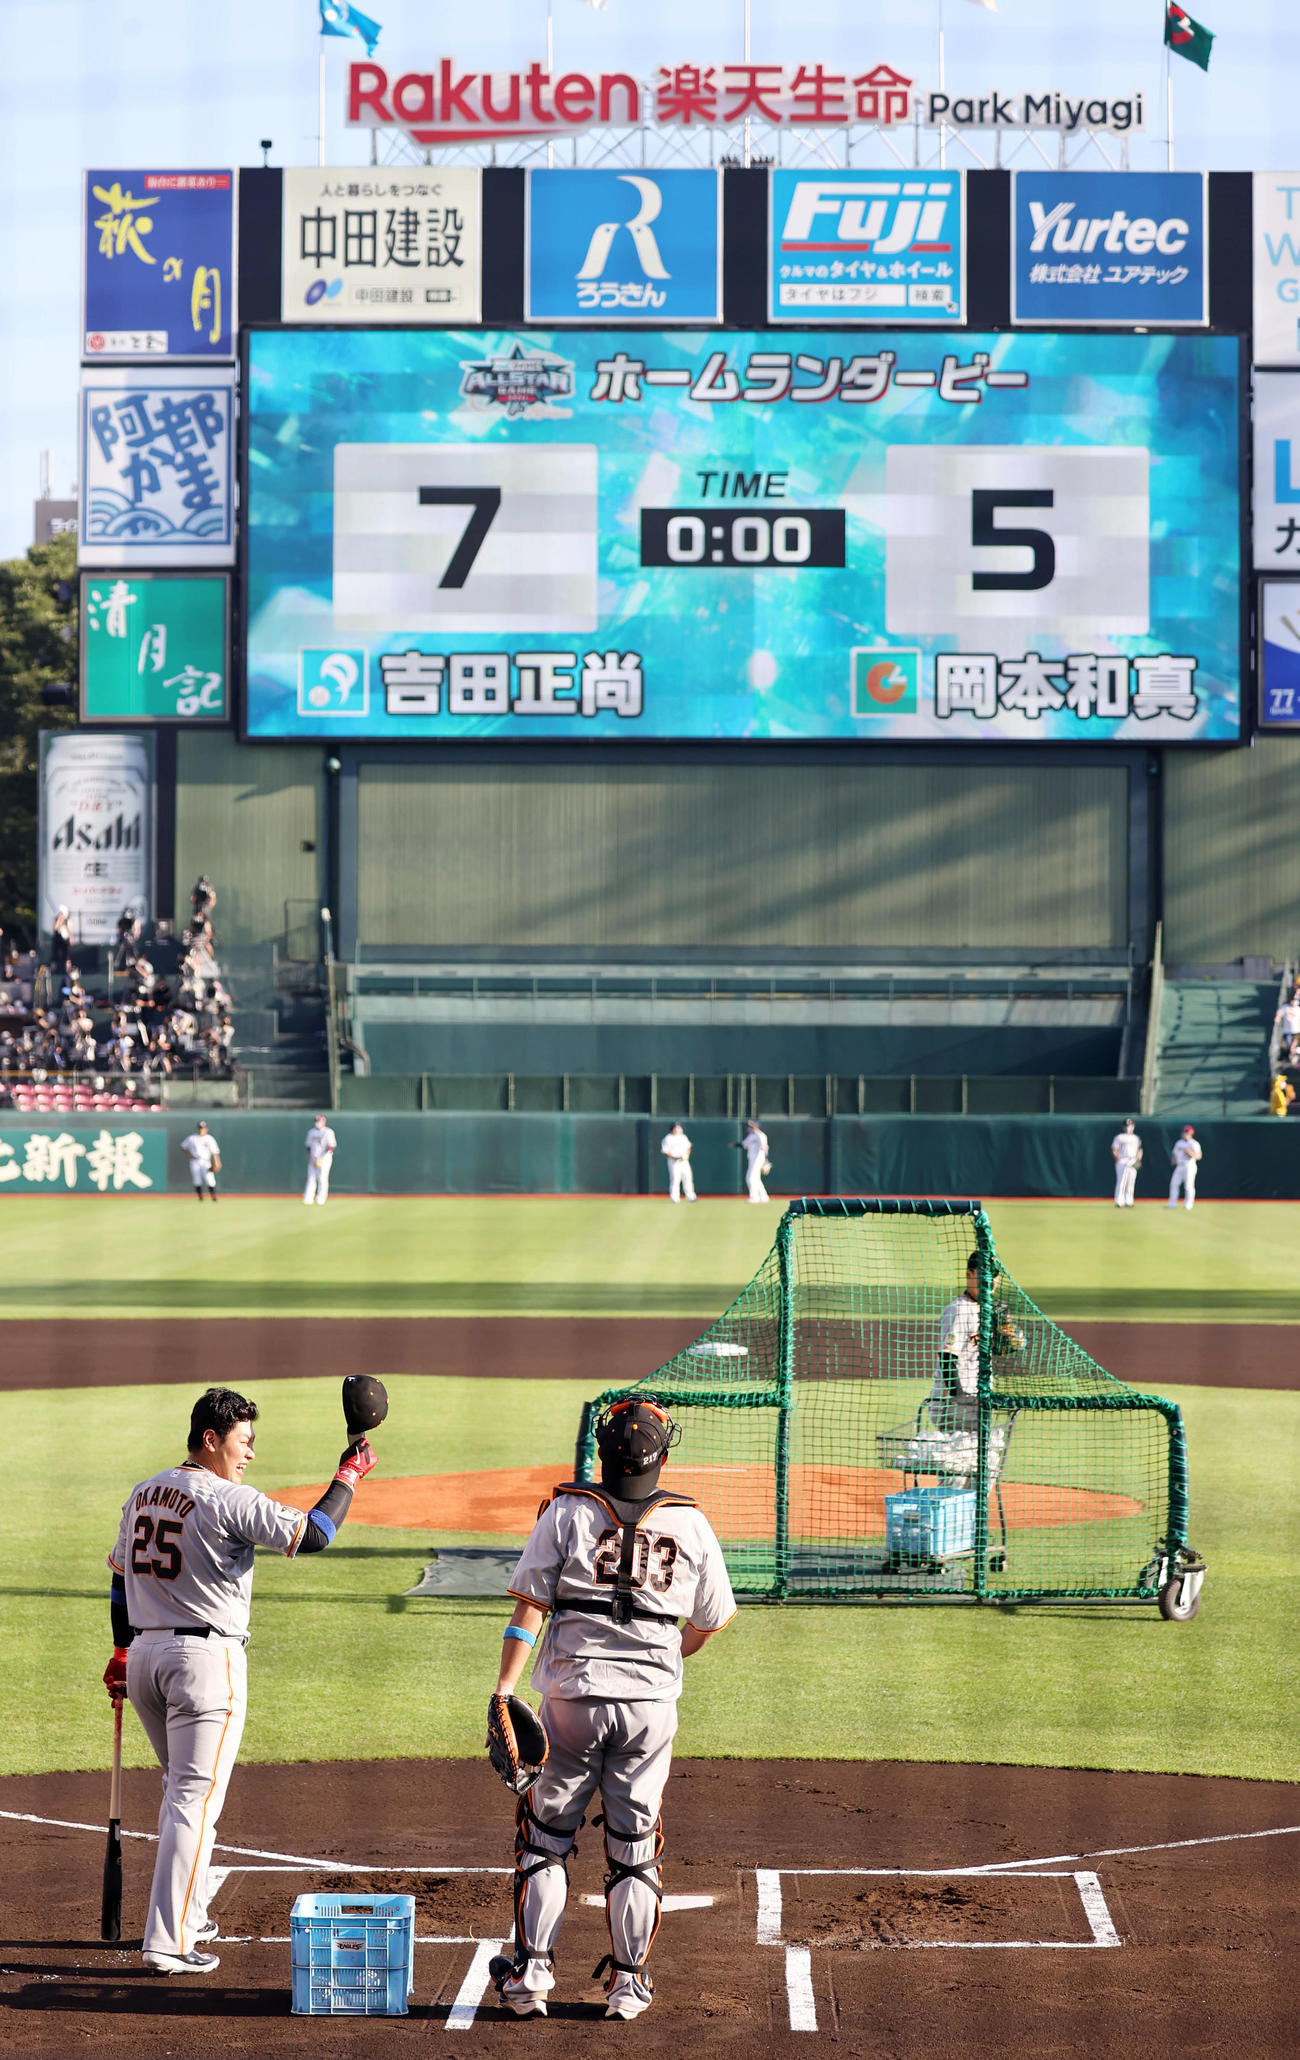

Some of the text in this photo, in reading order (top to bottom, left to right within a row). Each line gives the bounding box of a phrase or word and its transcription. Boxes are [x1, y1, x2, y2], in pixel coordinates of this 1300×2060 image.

[349, 59, 1144, 130] Rakuten 楽天生命 Park Miyagi
[320, 183, 443, 197] 人と暮らしをつなぐ
[781, 181, 953, 255] Fuji
[299, 206, 465, 270] 中田建設
[1028, 201, 1190, 256] Yurtec
[576, 281, 667, 308] ろうきん
[1029, 263, 1190, 285] 株式会社 ユアテック
[589, 351, 1029, 404] ホームランダービー
[90, 392, 225, 464] 阿部
[119, 447, 221, 510] かま
[697, 471, 789, 498] TIME
[418, 486, 502, 590] 7
[666, 515, 812, 563] 0:00
[971, 489, 1056, 592] 5
[87, 579, 223, 717] 清月記
[380, 650, 645, 719] 吉田正尚
[935, 653, 1199, 722] 岡本和真
[53, 812, 141, 851] Asahi
[642, 1451, 658, 1466] 217
[135, 1485, 197, 1520] OKAMOTO
[131, 1514, 184, 1582] 25
[593, 1527, 680, 1593] 203
